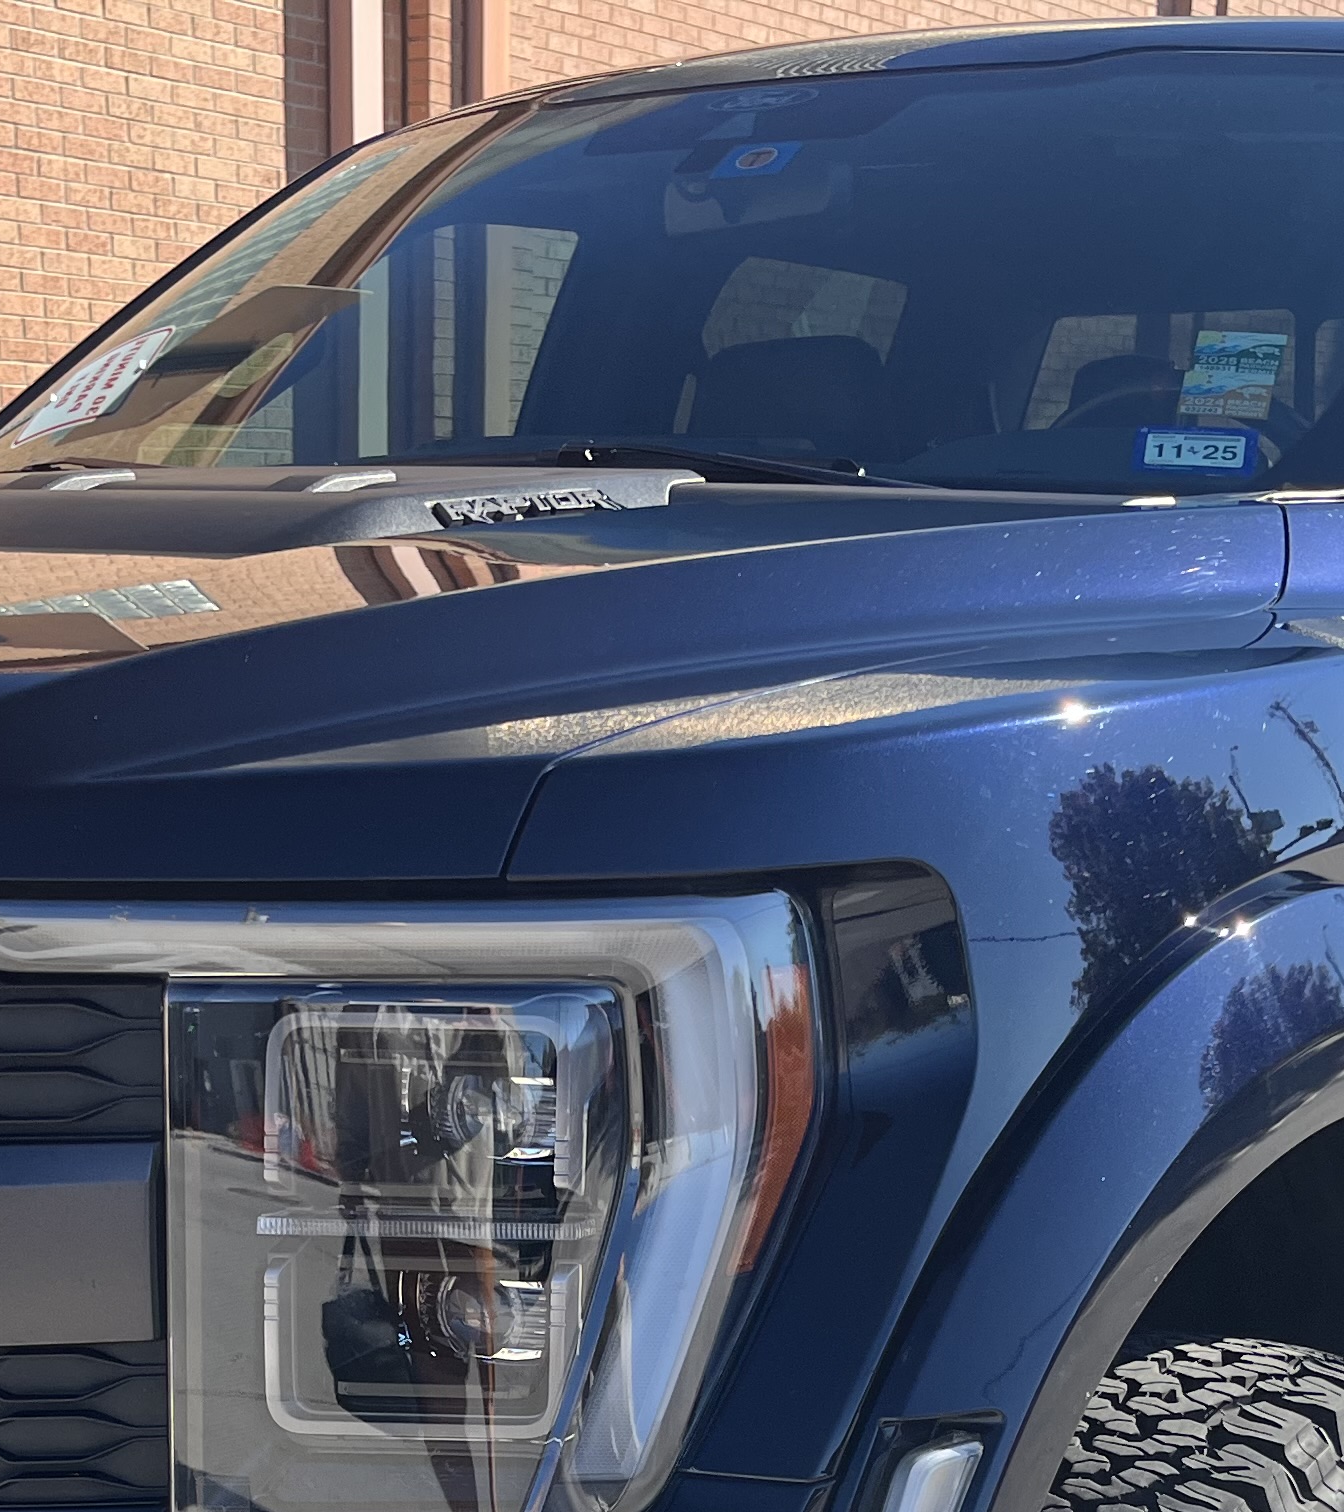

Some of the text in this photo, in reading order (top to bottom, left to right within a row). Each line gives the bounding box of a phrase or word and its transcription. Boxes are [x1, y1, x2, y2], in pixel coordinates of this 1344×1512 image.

[1152, 443, 1238, 461] 11 25
[431, 487, 624, 525] RAPTOR
